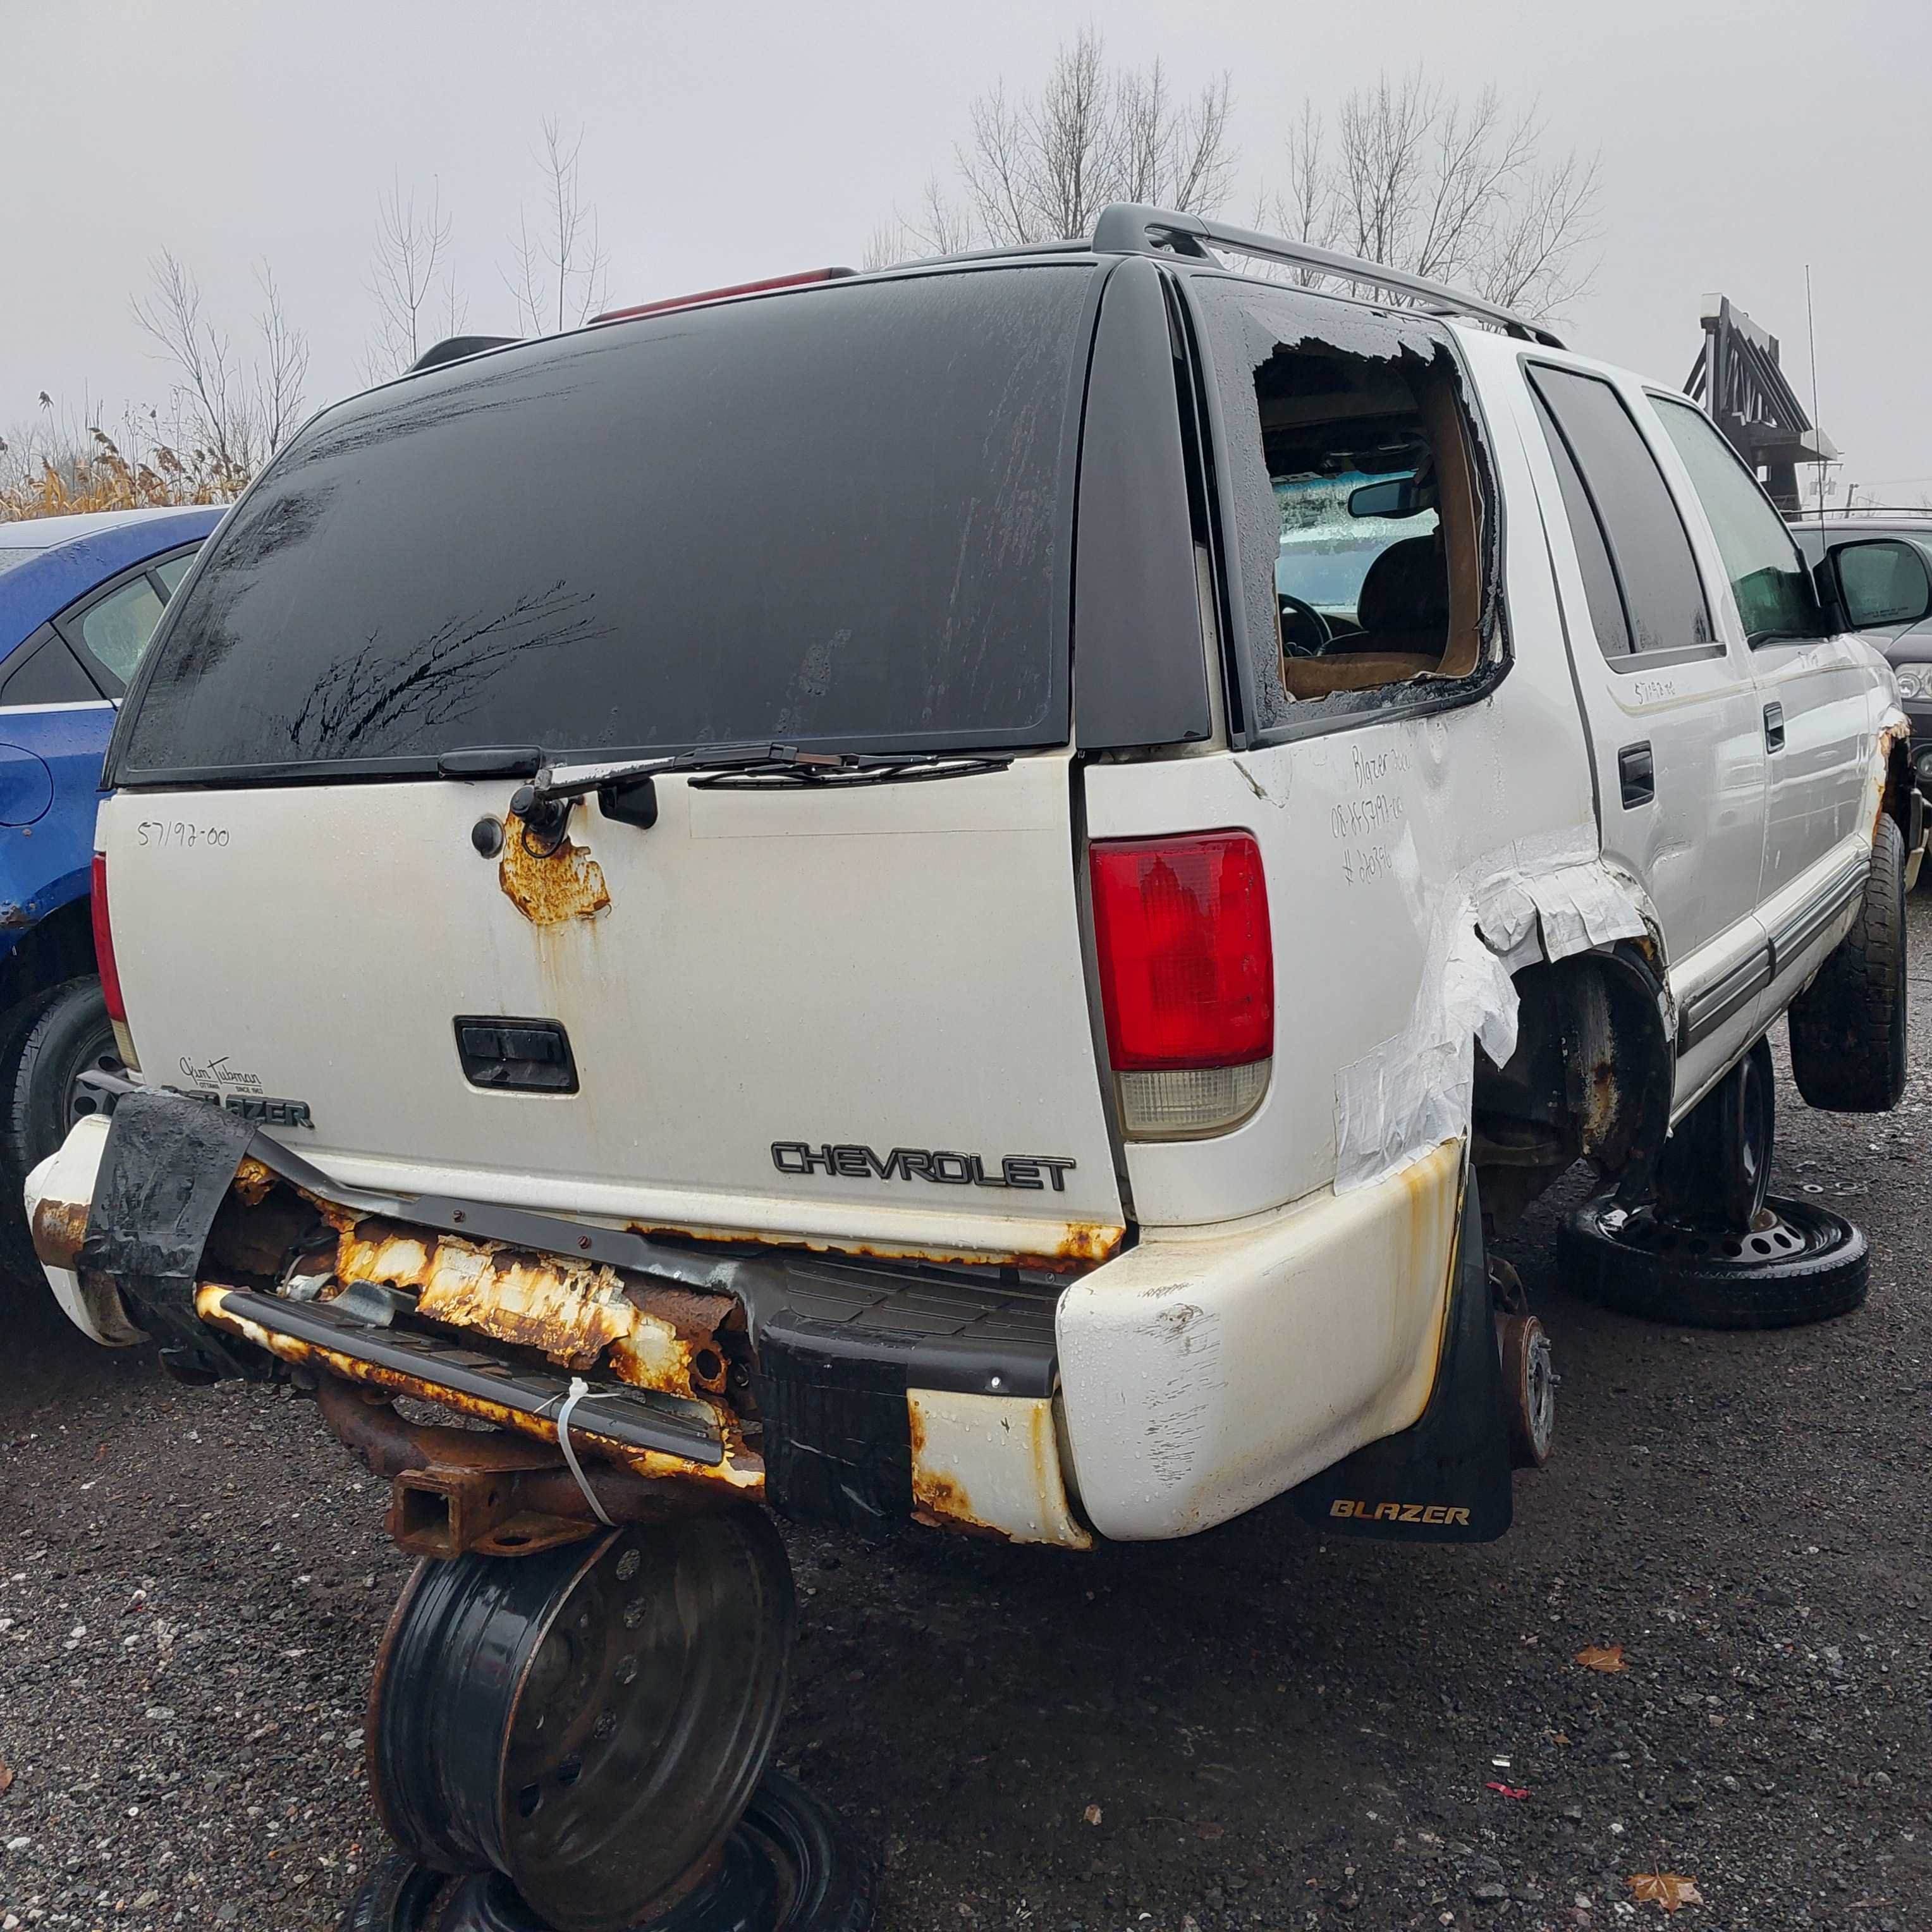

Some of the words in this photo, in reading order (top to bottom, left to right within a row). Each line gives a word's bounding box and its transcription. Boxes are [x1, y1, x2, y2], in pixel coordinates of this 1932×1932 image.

[1352, 745, 1388, 789] Blazer
[207, 1056, 262, 1085] Tubman
[199, 1082, 220, 1090] OTTAWA
[235, 1085, 250, 1094] SINCE
[771, 1141, 1076, 1191] CHEVROLET
[1330, 1499, 1471, 1526] BLAZER
